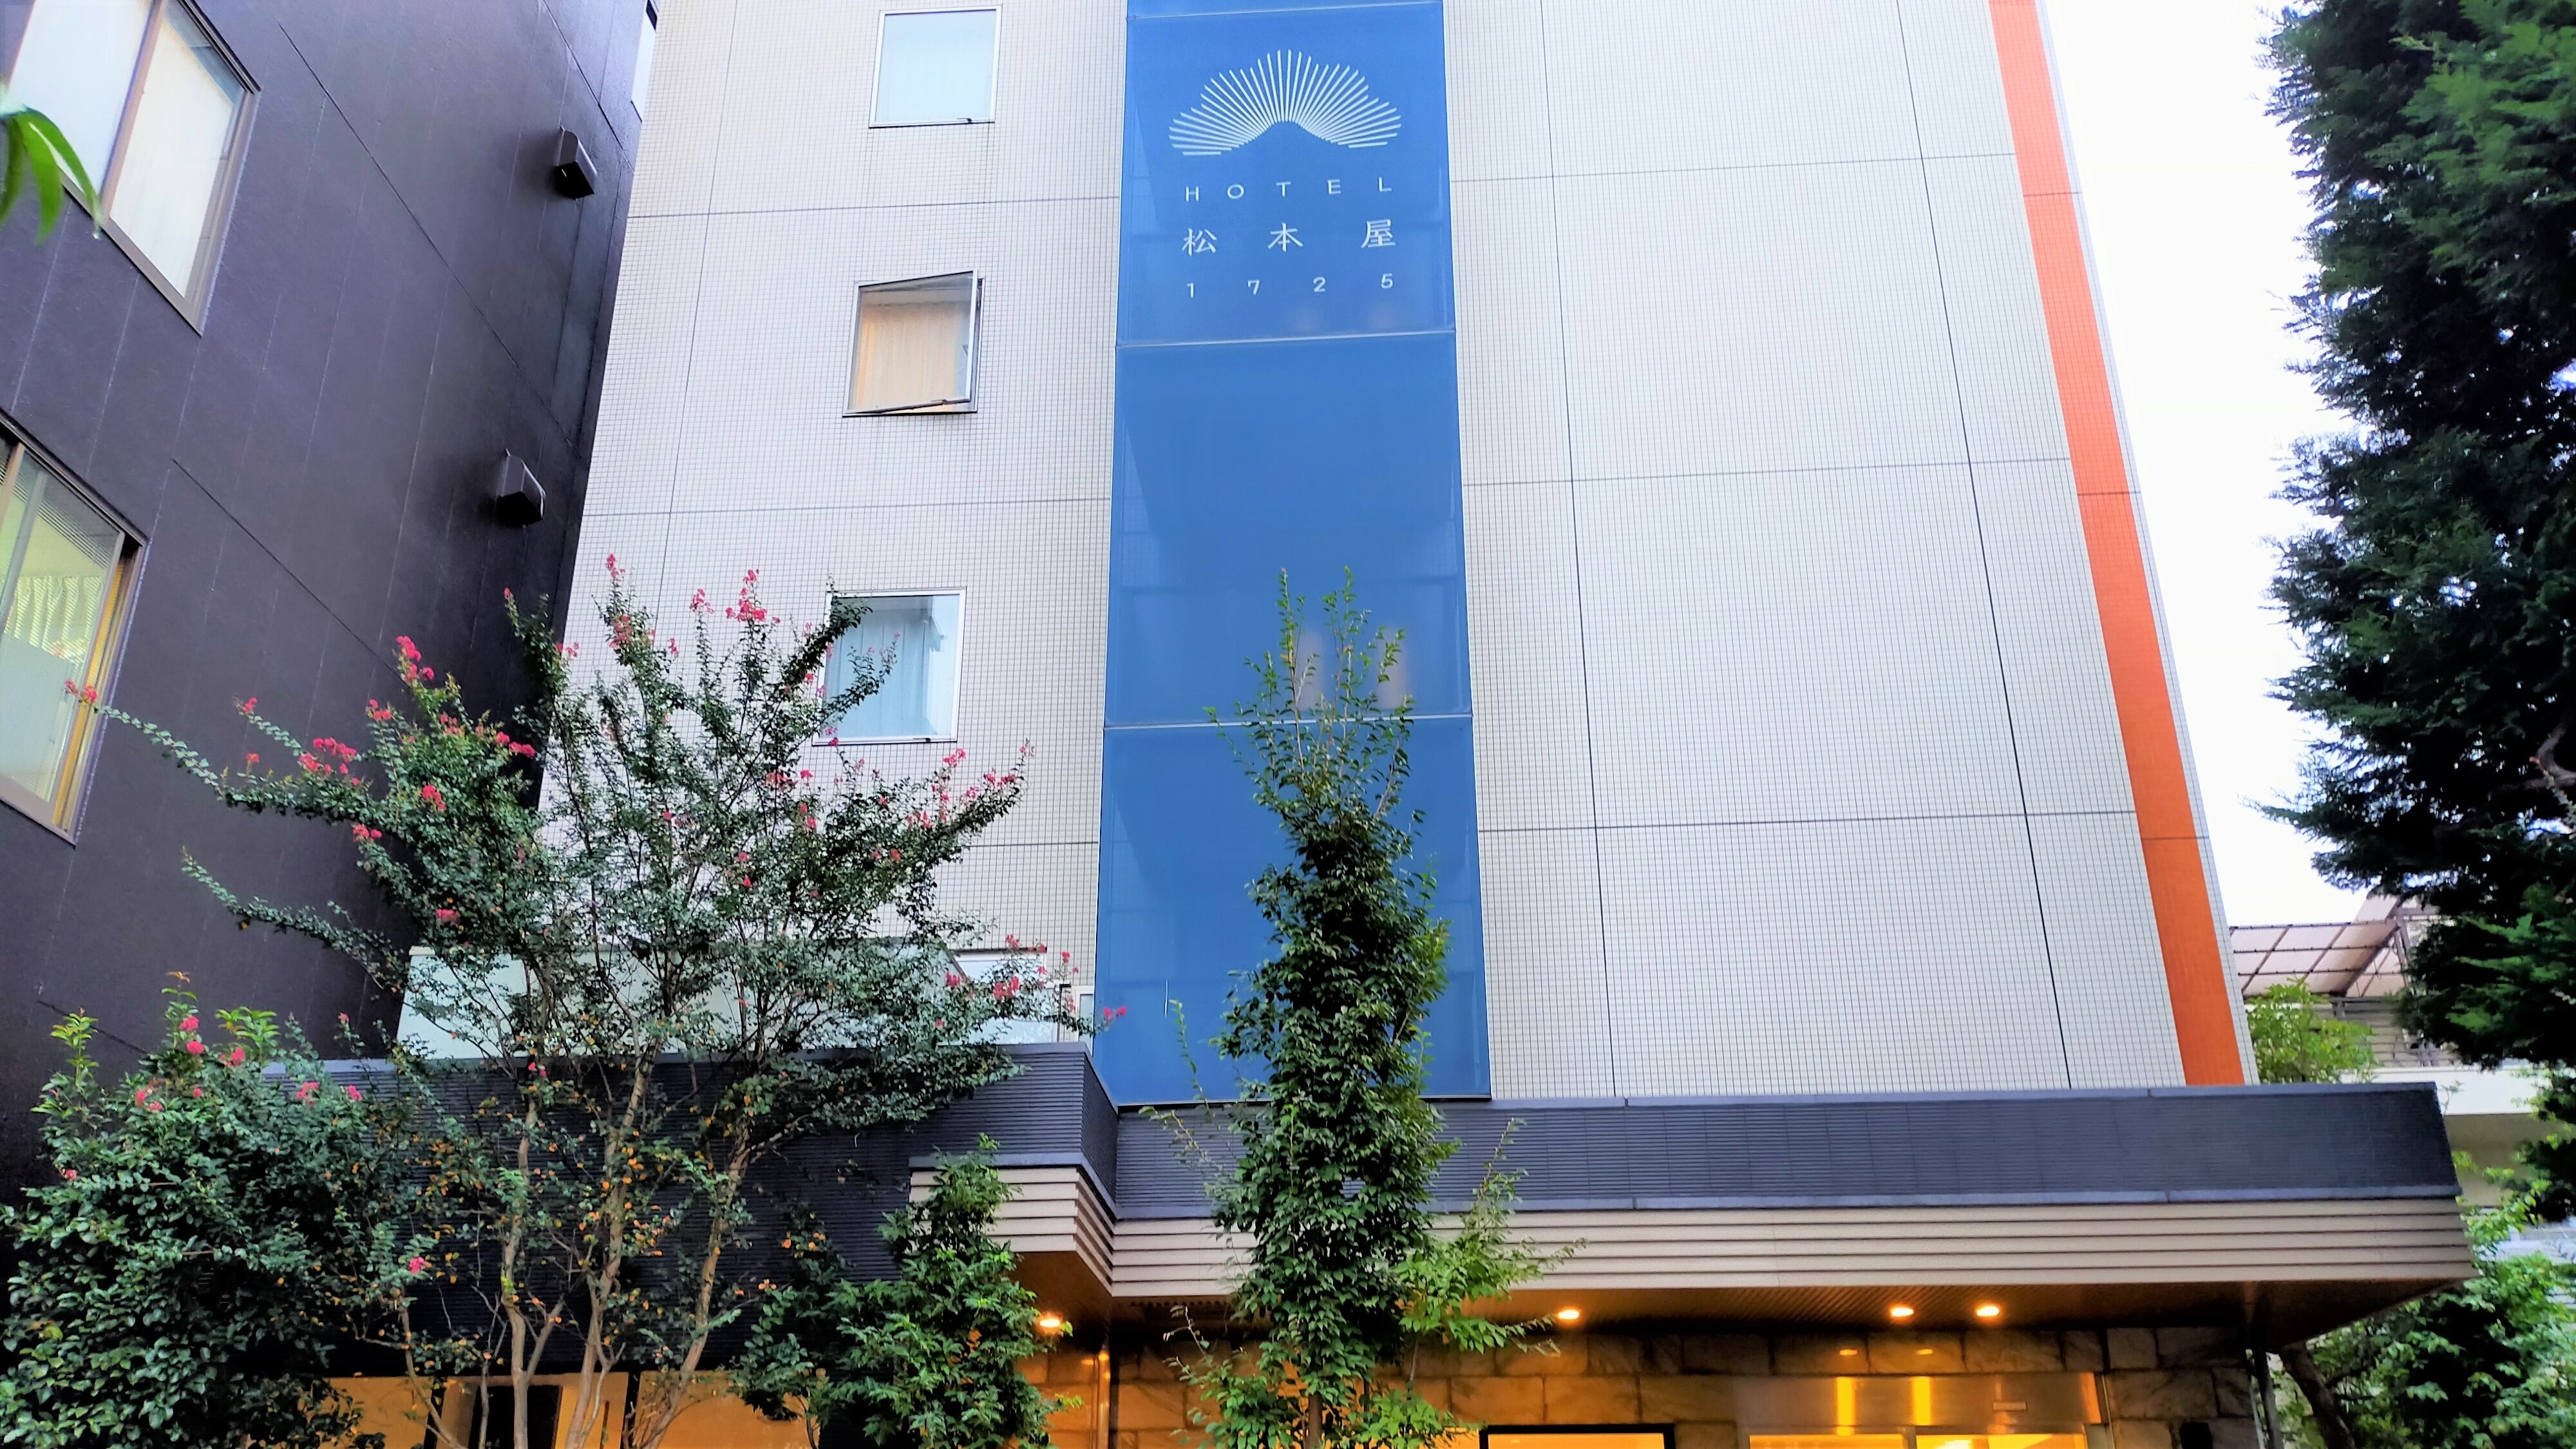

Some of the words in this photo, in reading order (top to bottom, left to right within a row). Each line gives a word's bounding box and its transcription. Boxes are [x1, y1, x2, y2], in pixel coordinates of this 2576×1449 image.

[1185, 177, 1392, 202] HOTEL
[1182, 219, 1396, 256] 松本屋
[1186, 274, 1394, 298] 1725
